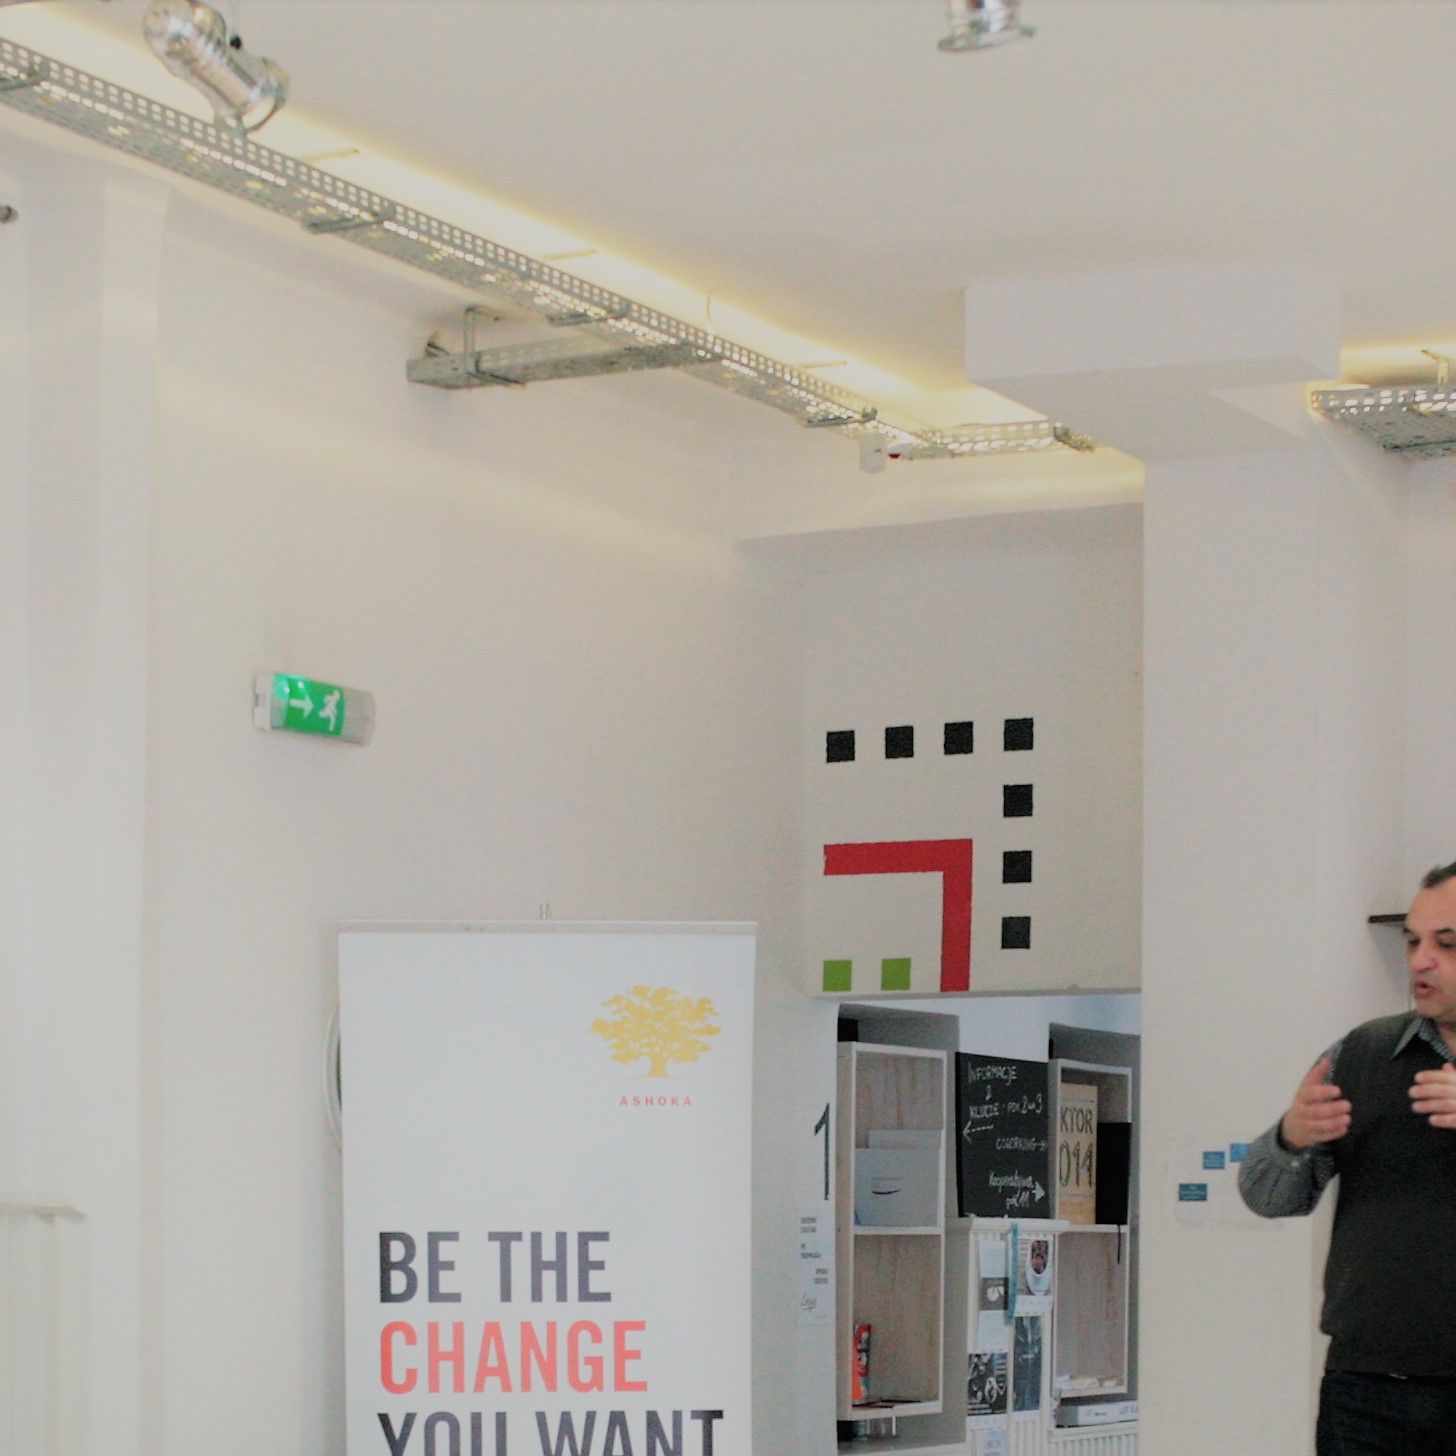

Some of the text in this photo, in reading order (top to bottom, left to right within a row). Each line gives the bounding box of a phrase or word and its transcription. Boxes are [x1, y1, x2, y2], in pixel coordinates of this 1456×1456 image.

[618, 1095, 693, 1107] ASHOKA
[378, 1230, 612, 1304] BE THE
[379, 1319, 649, 1395] CHANGE
